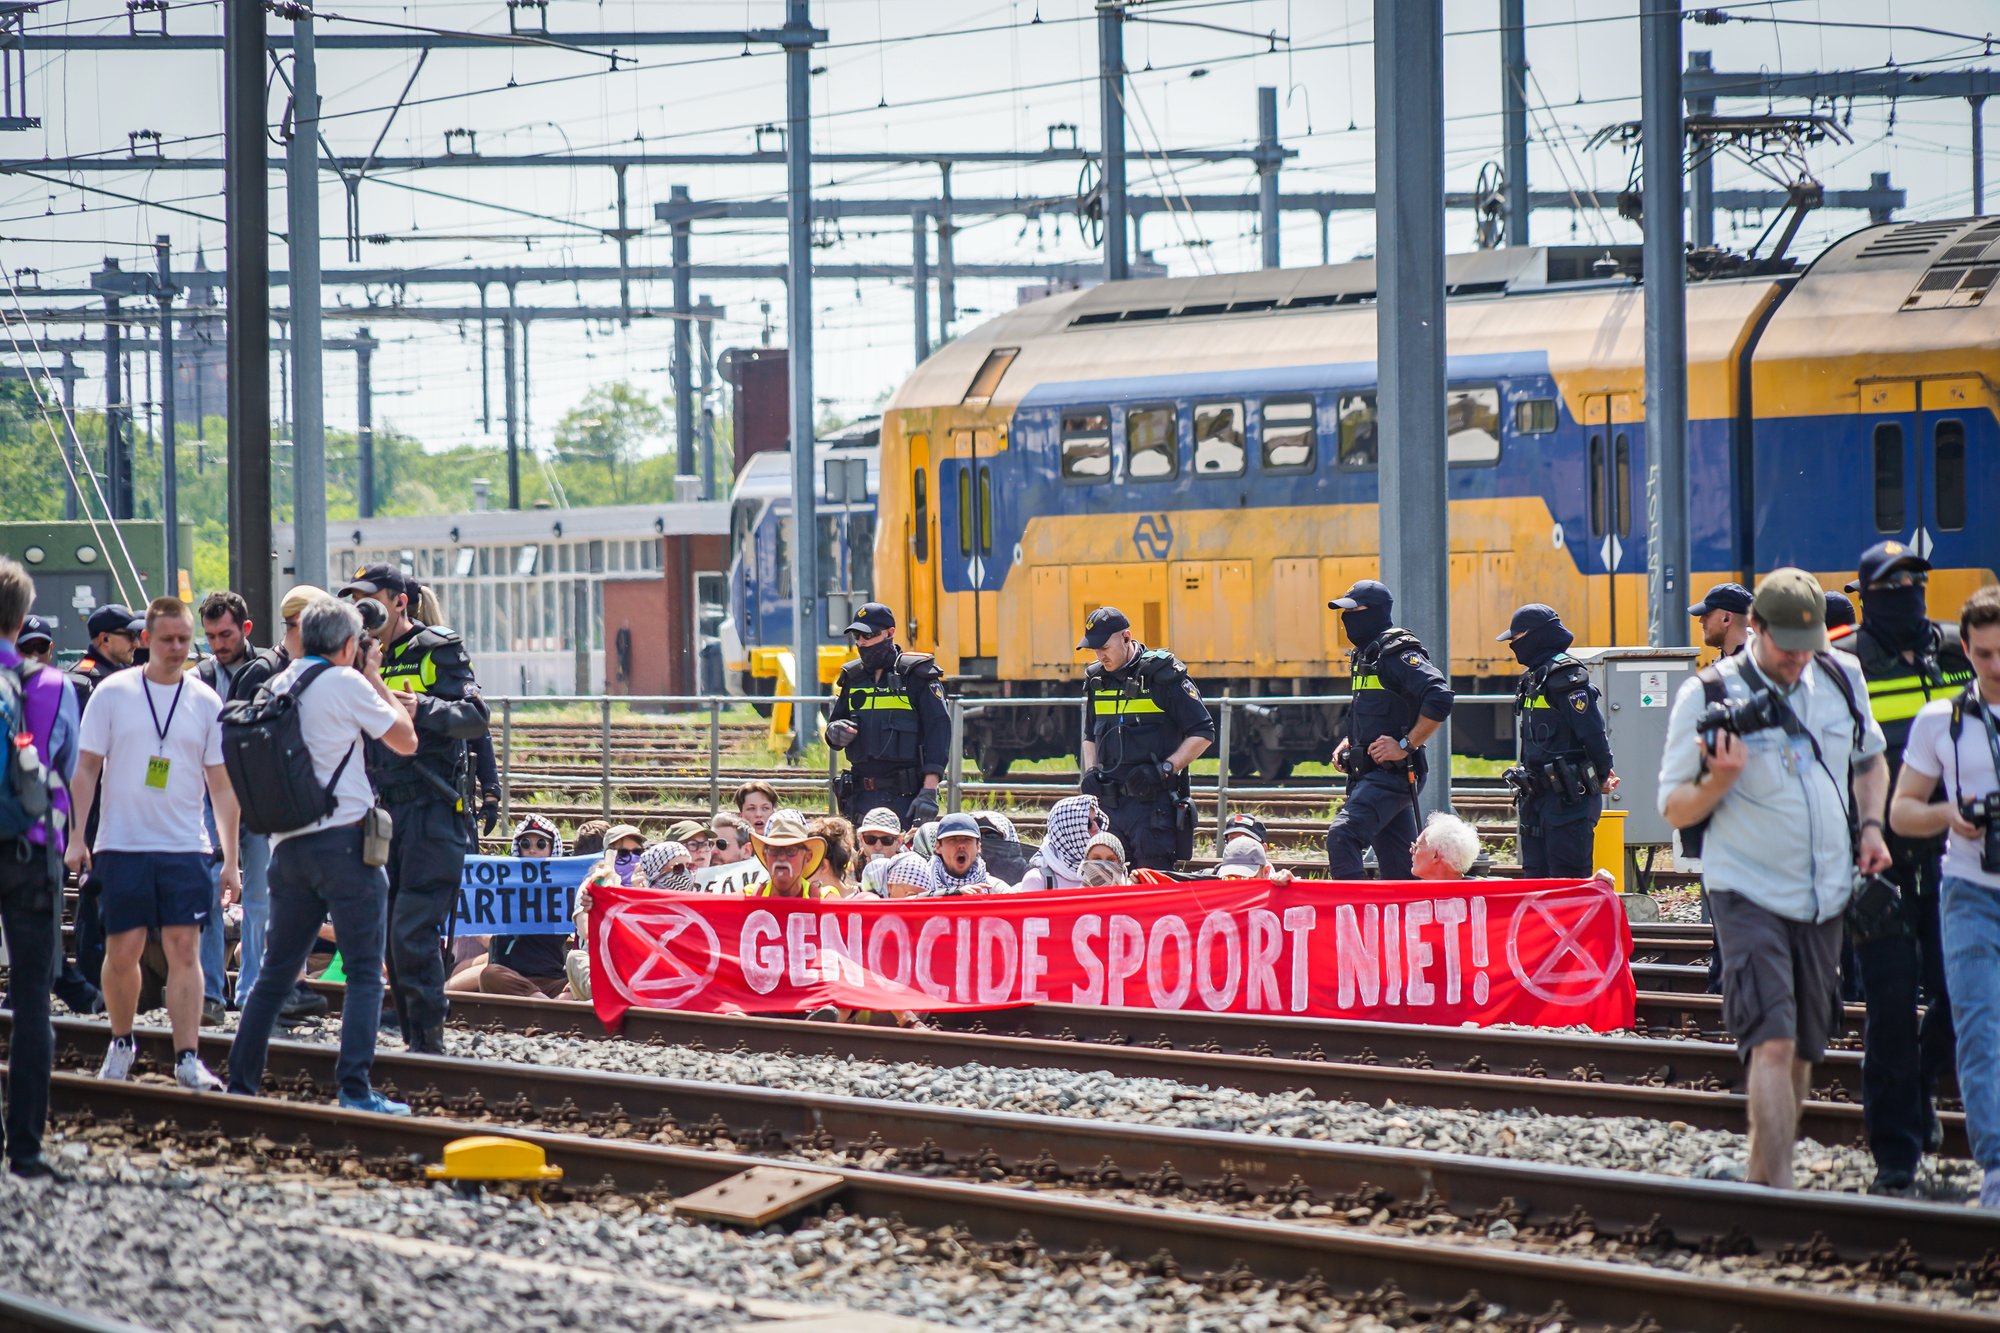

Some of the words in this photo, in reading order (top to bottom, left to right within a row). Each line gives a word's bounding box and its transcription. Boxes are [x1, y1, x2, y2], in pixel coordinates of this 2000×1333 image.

[464, 862, 511, 885] TOP
[521, 861, 552, 884] DE
[740, 909, 1050, 1003] GENOCIDE
[1072, 905, 1316, 1012] SPOORT
[1335, 896, 1488, 1009] NIET!
